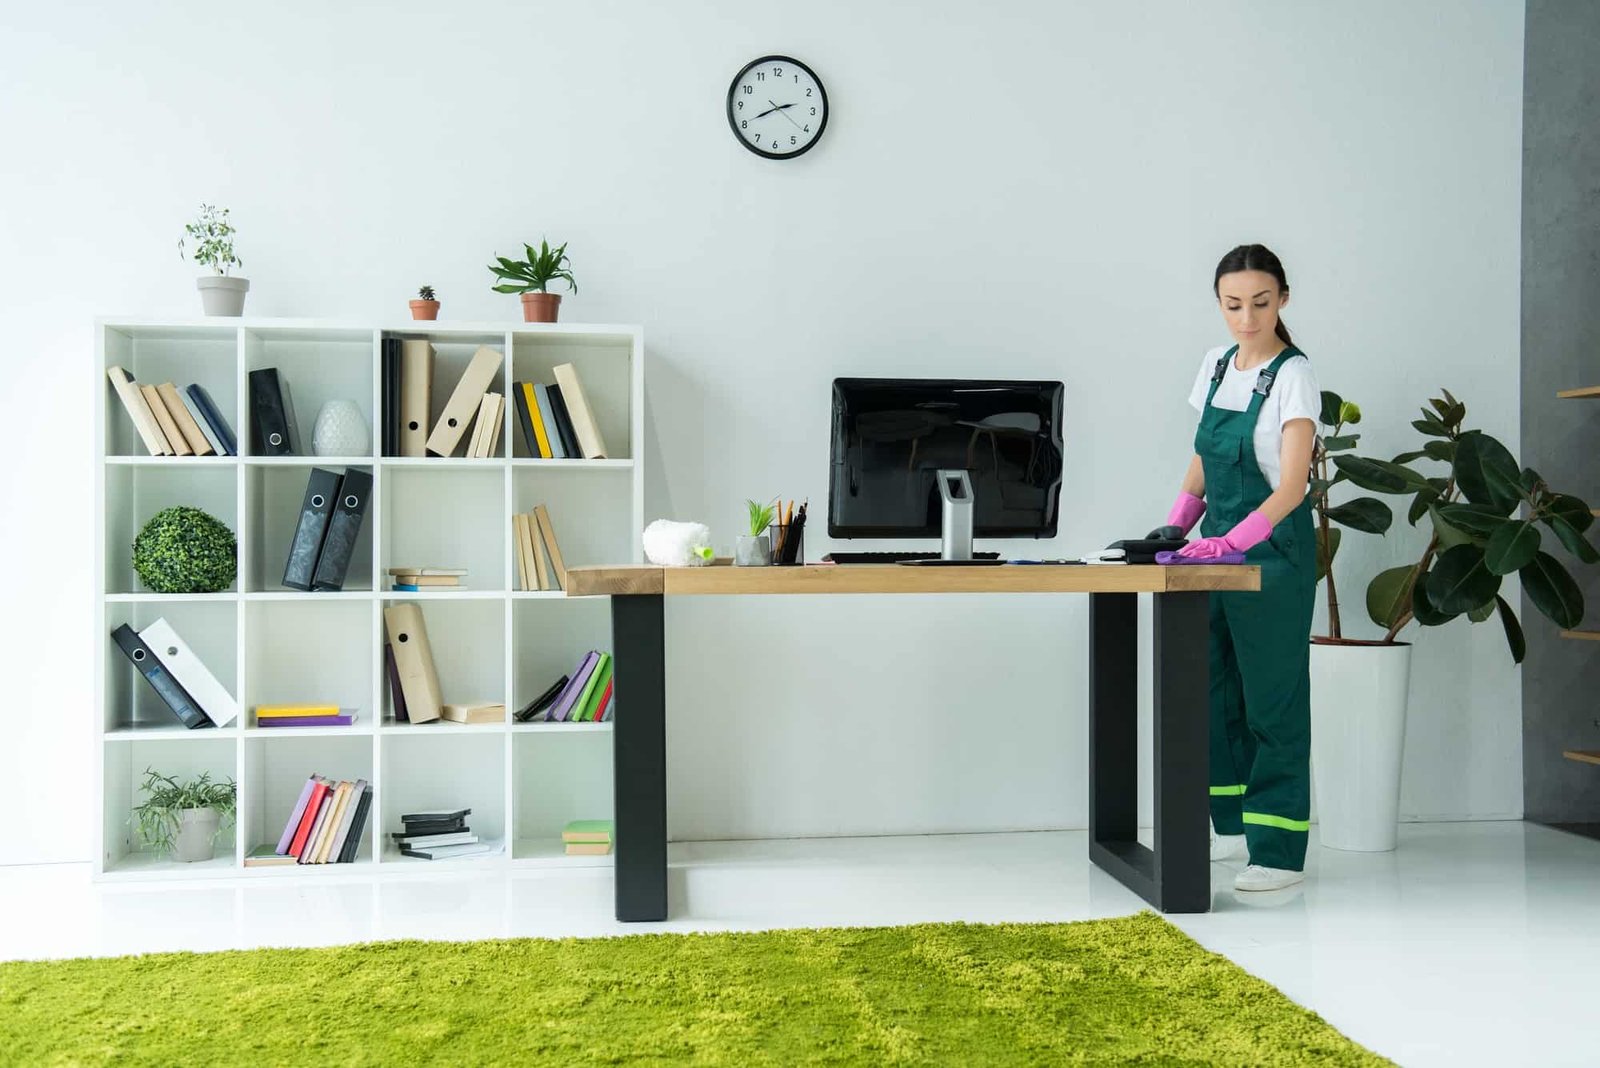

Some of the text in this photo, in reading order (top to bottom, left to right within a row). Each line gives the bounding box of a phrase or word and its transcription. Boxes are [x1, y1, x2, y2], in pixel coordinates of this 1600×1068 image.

[756, 72, 765, 81] 11
[772, 67, 783, 78] 12
[743, 85, 753, 95] 10
[806, 88, 812, 97] 2
[737, 101, 744, 110] 9
[809, 107, 816, 116] 3
[741, 120, 748, 129] 8
[803, 124, 809, 133] 4
[754, 133, 761, 143] 7
[790, 136, 797, 145] 5
[772, 140, 778, 149] 6
